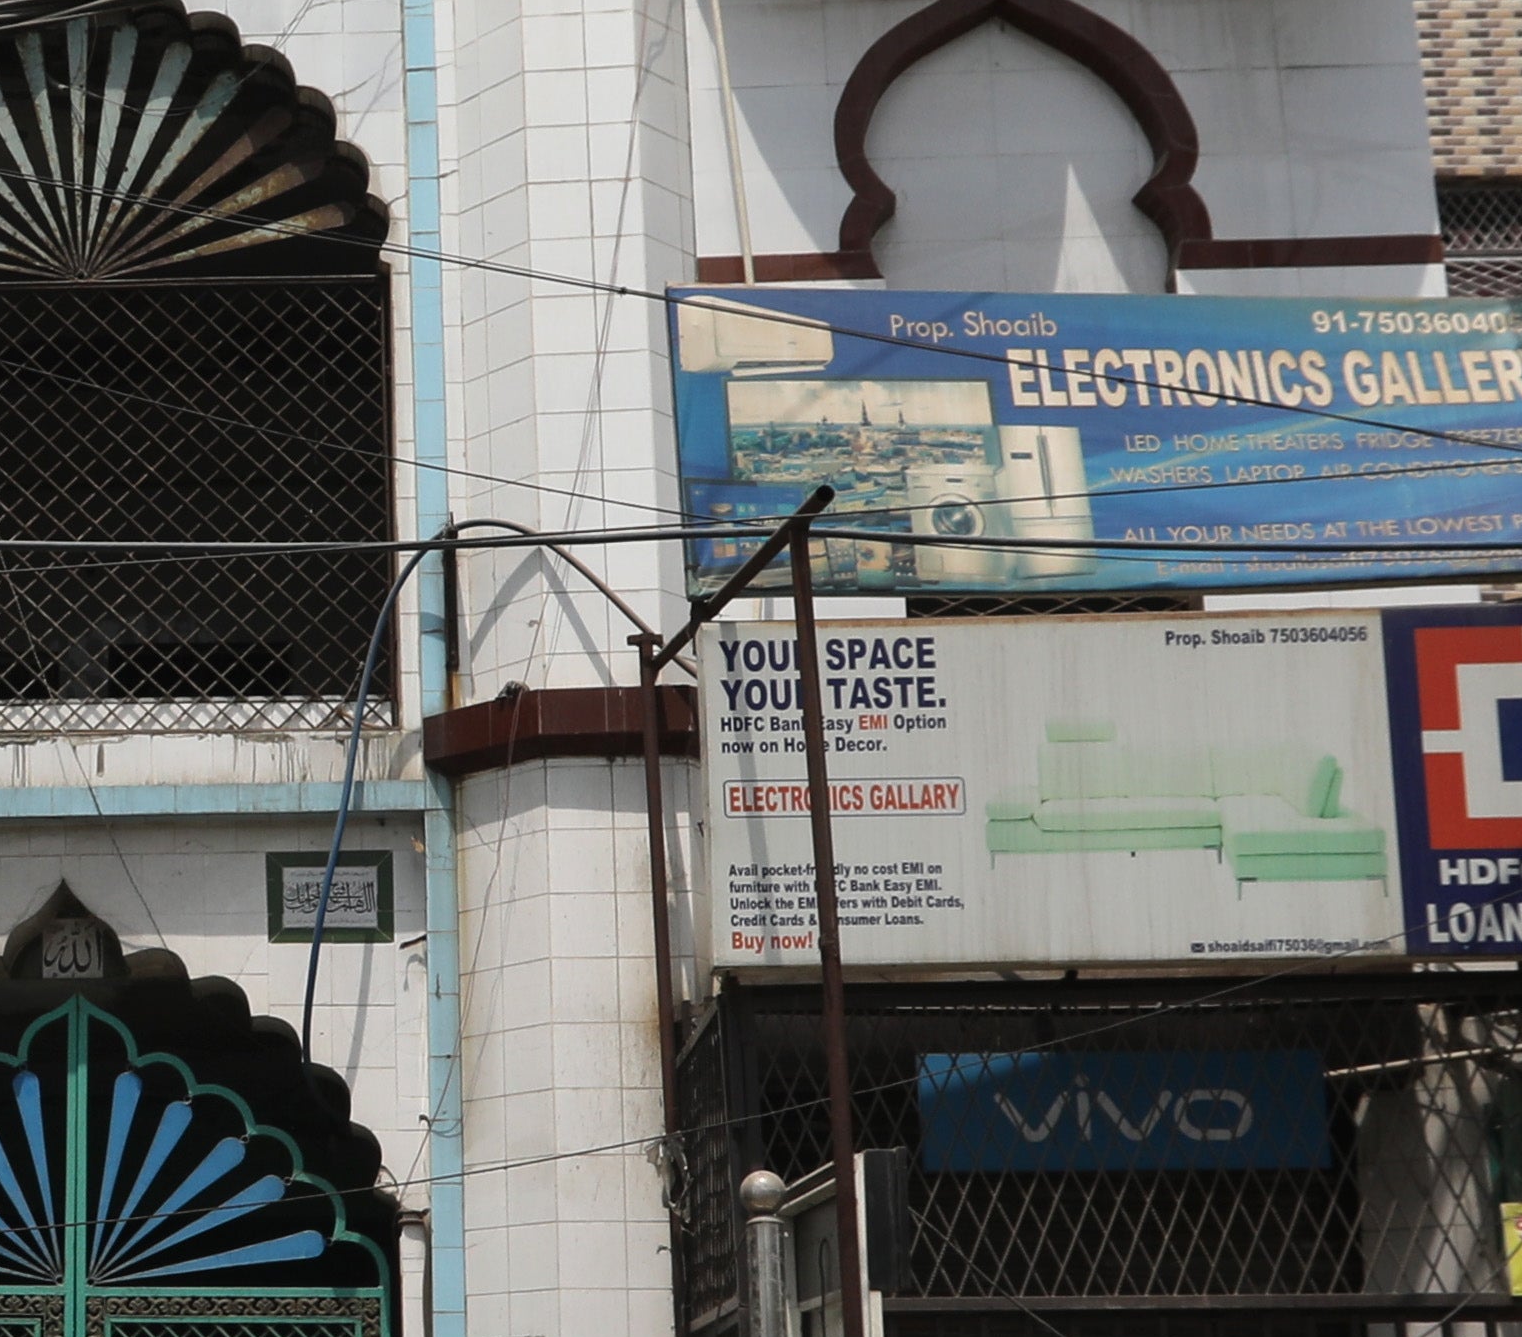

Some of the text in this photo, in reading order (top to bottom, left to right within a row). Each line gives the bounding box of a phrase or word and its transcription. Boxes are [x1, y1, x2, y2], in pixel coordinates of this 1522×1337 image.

[890, 311, 1058, 342] Prop. Shoaib
[1007, 347, 1335, 408] ELECTRONICS
[1125, 434, 1161, 453] LED
[1174, 433, 1241, 452] HOME
[1246, 431, 1345, 452] THEATERS
[1356, 430, 1434, 449] FRIDGE
[1111, 466, 1214, 485] WASHERS
[1225, 465, 1306, 484] LAPTOP
[1320, 463, 1353, 481] AIR
[1167, 524, 1232, 544] YOUR
[1240, 522, 1316, 541] NEEDS
[1323, 520, 1350, 539] AT
[1357, 517, 1400, 537] THE
[1407, 514, 1505, 536] LOWEST
[1165, 626, 1368, 649] Prop. Shoaib 7503604056
[825, 637, 937, 671] SPACE
[826, 676, 947, 710] TASTE.
[720, 716, 765, 733] HDFC
[858, 714, 889, 730] EMI
[893, 713, 947, 734] Option
[721, 736, 888, 754] now on Hoe Decor.
[869, 782, 960, 811] GALLARY
[728, 862, 943, 879] Avail pocket-frdly no cost EMI on
[729, 881, 781, 894] furniture
[784, 880, 810, 893] with
[850, 879, 881, 892] Bank
[883, 879, 913, 895] Easy
[915, 878, 942, 892] EMI.
[730, 897, 772, 910] Unlock
[775, 898, 795, 910] the
[861, 895, 888, 909] with
[891, 895, 923, 908] Debit
[926, 894, 965, 911] Cards,
[730, 912, 924, 927] Credit Cards & nsumer Loans.
[731, 930, 814, 954] Buy now!
[993, 1073, 1253, 1142] vivo
